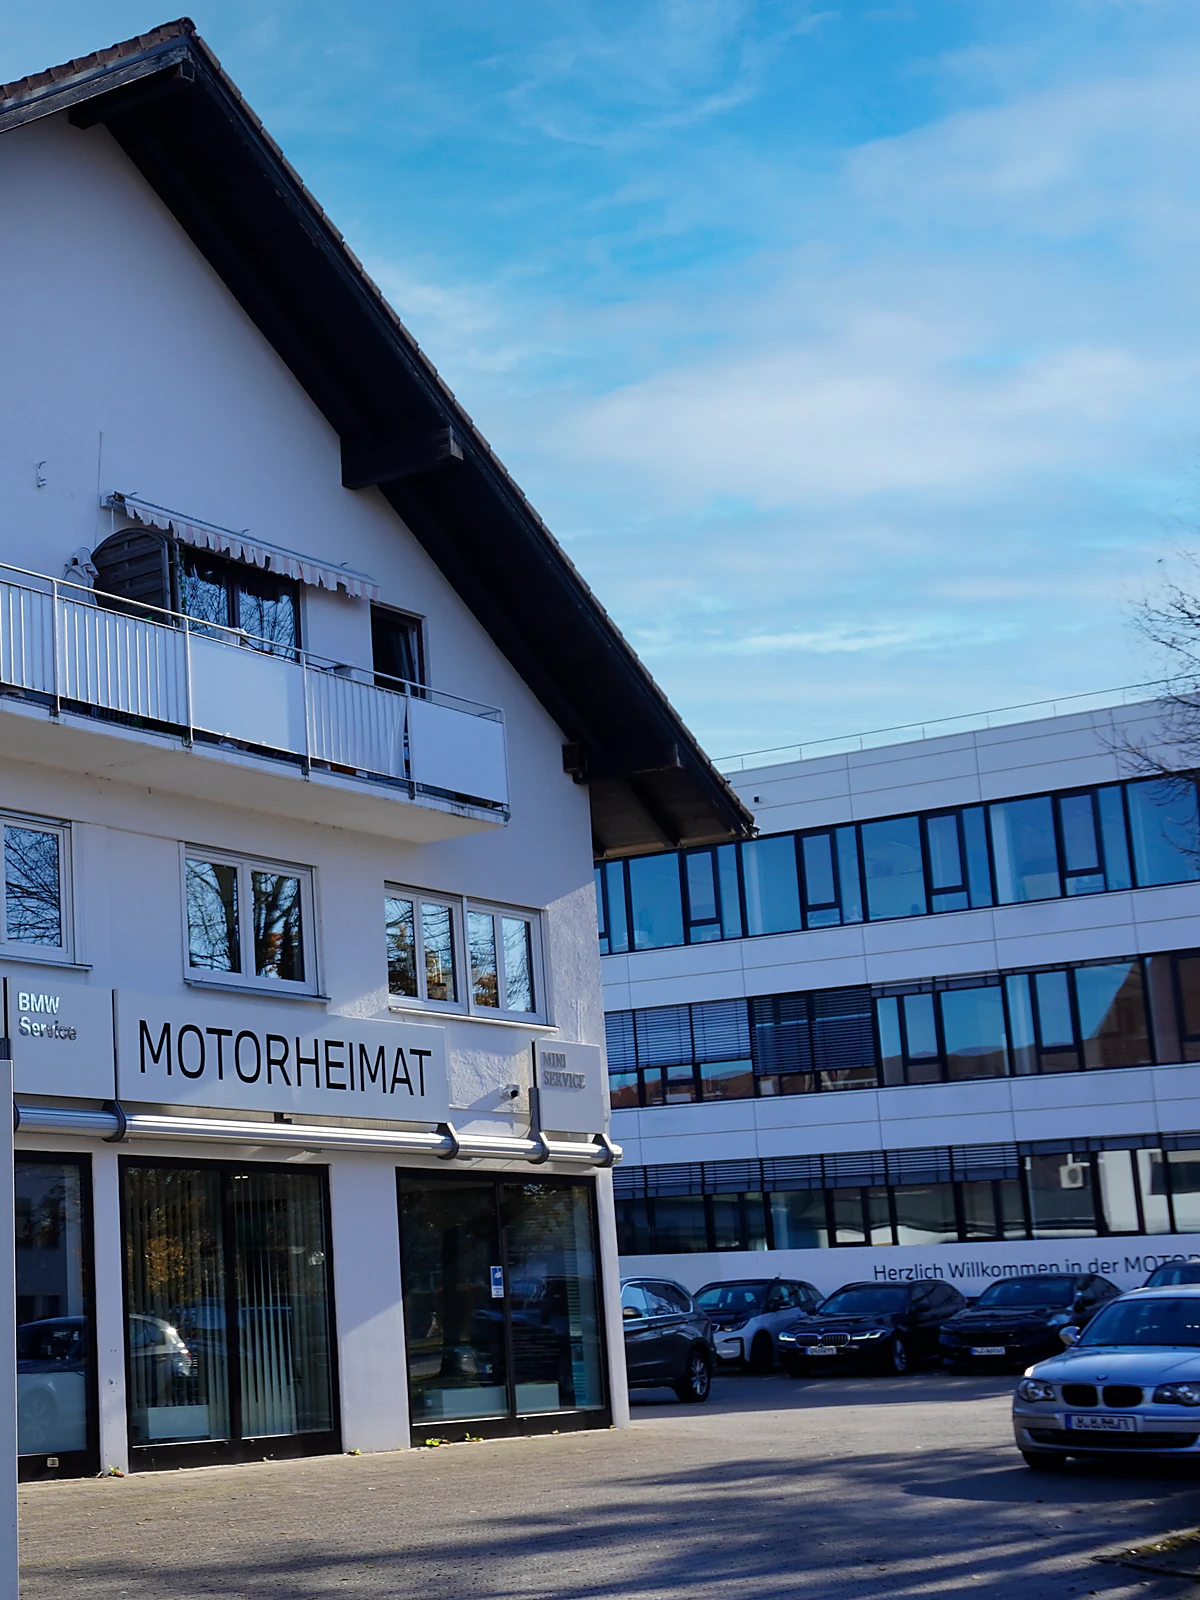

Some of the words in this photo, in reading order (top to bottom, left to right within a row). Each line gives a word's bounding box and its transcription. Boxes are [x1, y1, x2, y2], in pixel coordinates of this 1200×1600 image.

[18, 991, 60, 1015] BMW
[19, 1016, 77, 1040] Service
[138, 1019, 432, 1097] MOTORHEIMAT
[541, 1051, 567, 1068] MINI
[543, 1070, 586, 1089] SERVICE
[874, 1263, 944, 1281] Herzlich
[948, 1259, 1061, 1279] Willkommen
[1065, 1258, 1082, 1274] in
[1088, 1257, 1119, 1274] der
